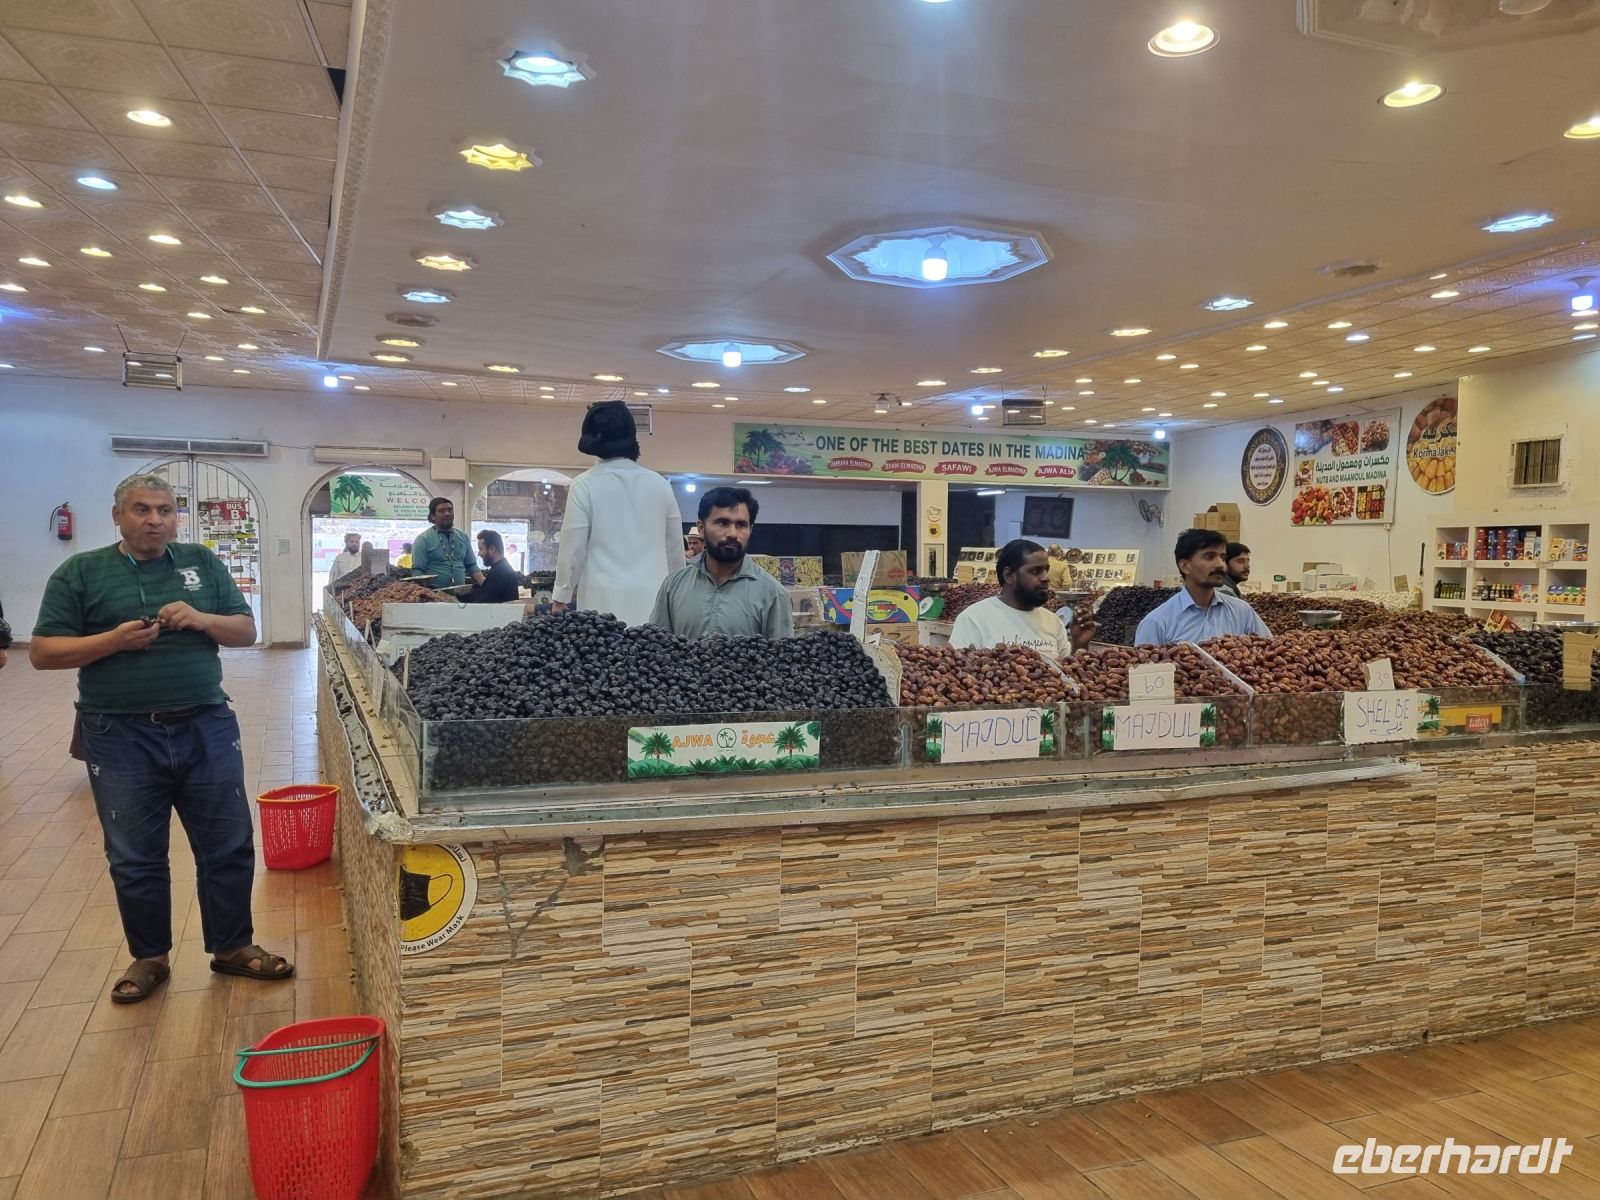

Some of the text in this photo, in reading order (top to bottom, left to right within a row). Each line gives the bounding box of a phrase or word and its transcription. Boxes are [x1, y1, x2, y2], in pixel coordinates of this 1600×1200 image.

[815, 435, 1085, 460] ONE OF THE BEST DATES IN THE MADINA
[941, 463, 972, 472] SAFAWI
[1038, 467, 1075, 476] AJWA ALIA
[1315, 455, 1390, 473] مكسرات ومعمول المدينة
[1329, 475, 1339, 483] AND
[1366, 471, 1387, 480] MADINA
[180, 570, 200, 586] B
[1115, 711, 1199, 740] MAJDUL
[672, 735, 714, 748] AJWA
[740, 730, 776, 748] عجوة
[426, 932, 446, 947] Wear
[446, 914, 465, 935] Mask
